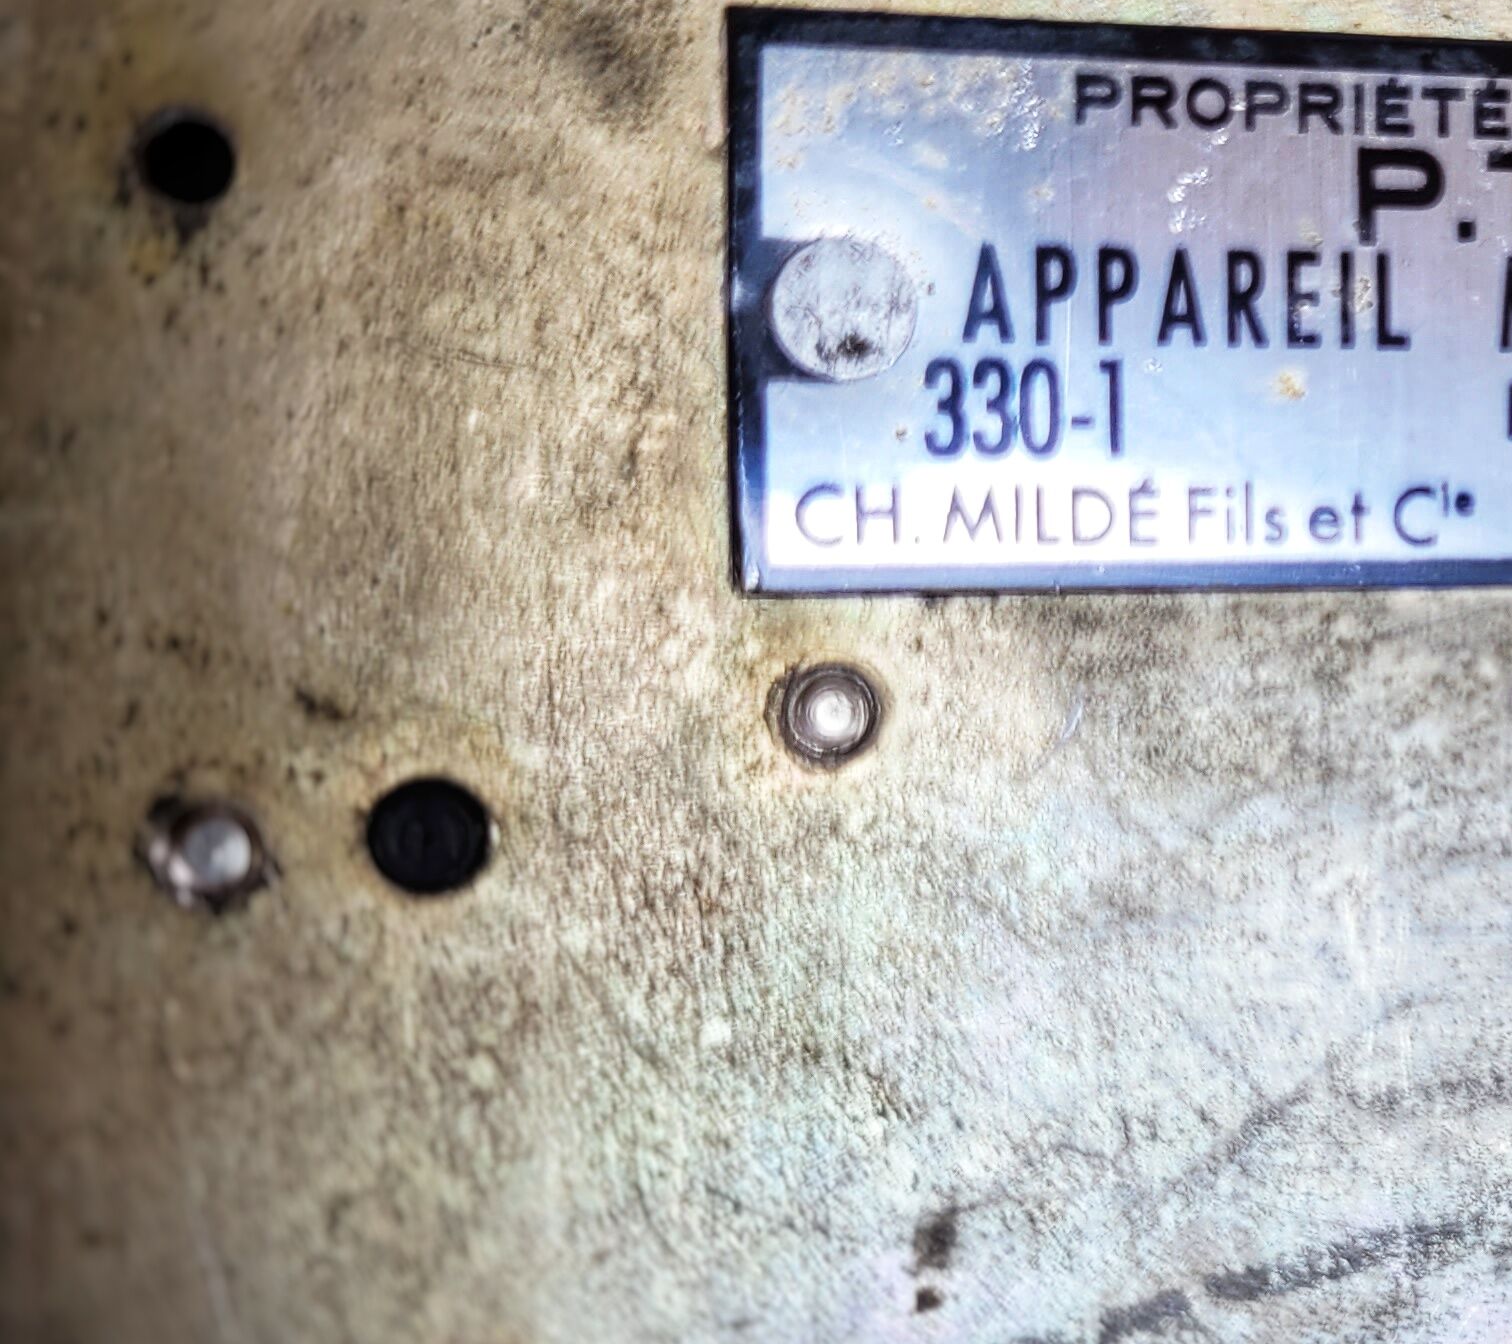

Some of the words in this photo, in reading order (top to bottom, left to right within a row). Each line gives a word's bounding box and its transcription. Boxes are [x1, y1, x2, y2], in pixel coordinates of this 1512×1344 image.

[1073, 73, 1511, 142] PROPRIÉTÉ
[962, 242, 1411, 351] APPAREIL
[923, 359, 1126, 457] 330-1
[794, 483, 922, 546] CH.
[941, 477, 1158, 547] MILDÉ
[1185, 484, 1288, 546] Fils
[1307, 490, 1370, 545] et
